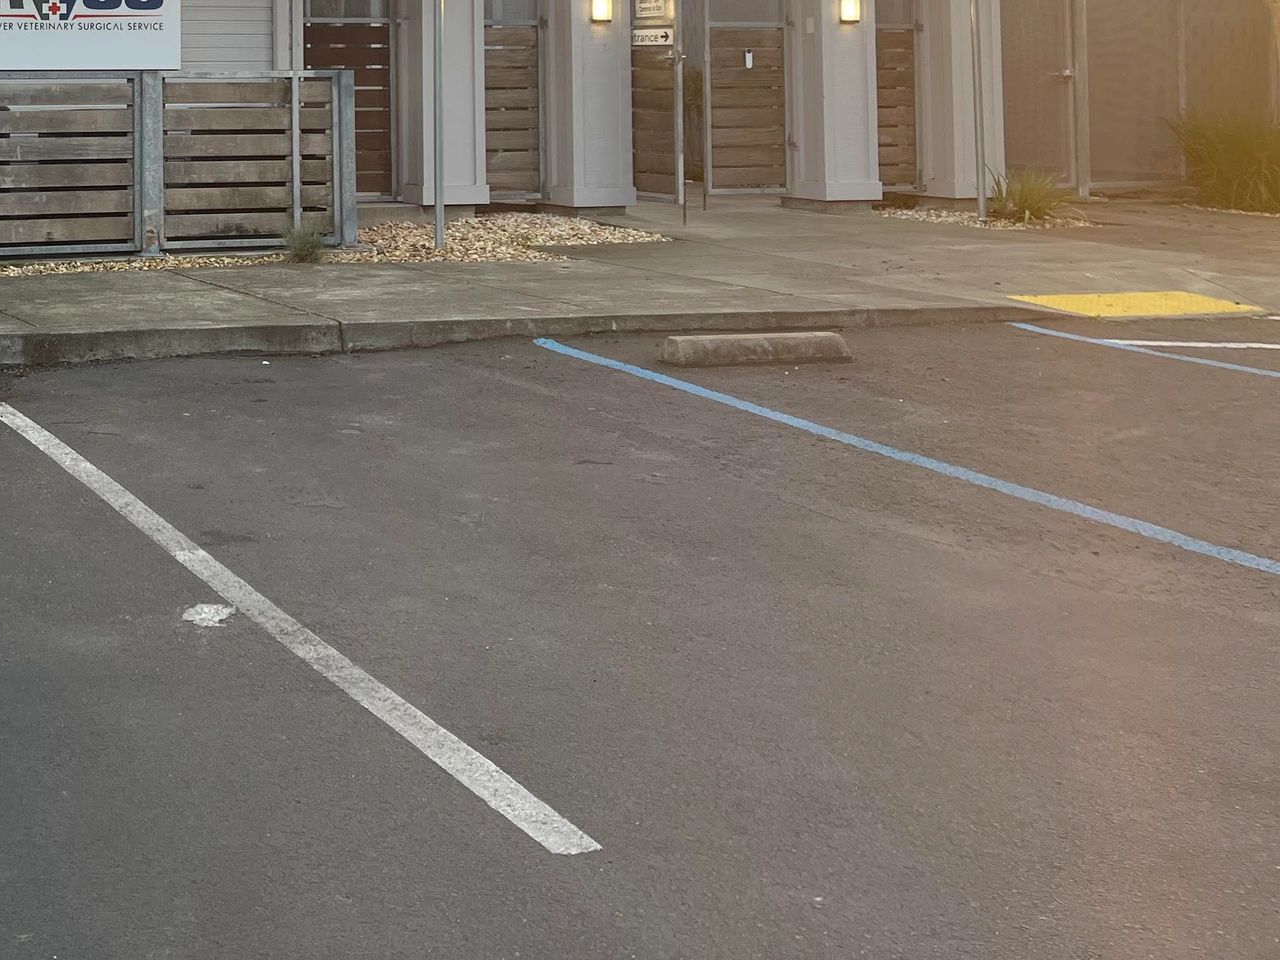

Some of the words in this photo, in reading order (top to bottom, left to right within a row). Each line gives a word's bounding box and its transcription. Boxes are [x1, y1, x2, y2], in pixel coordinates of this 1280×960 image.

[17, 21, 74, 31] VETERINARY
[78, 21, 123, 31] SURGICAL
[127, 21, 164, 31] SERVICE
